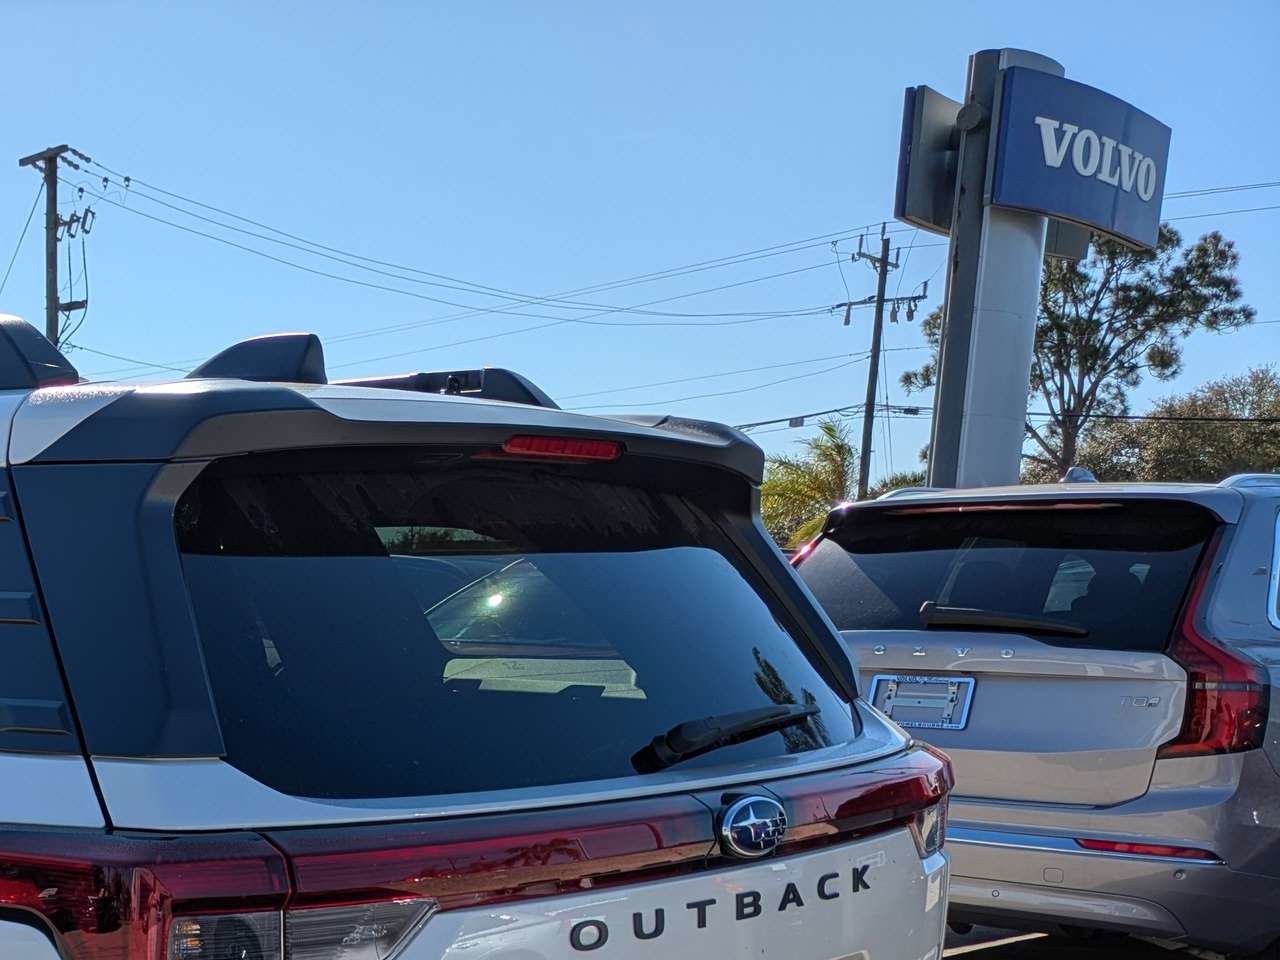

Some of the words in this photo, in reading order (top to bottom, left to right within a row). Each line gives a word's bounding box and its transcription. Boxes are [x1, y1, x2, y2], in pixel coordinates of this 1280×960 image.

[1035, 116, 1157, 203] VOLVO
[874, 644, 1015, 659] OLVO
[570, 864, 870, 951] OUTBACK
